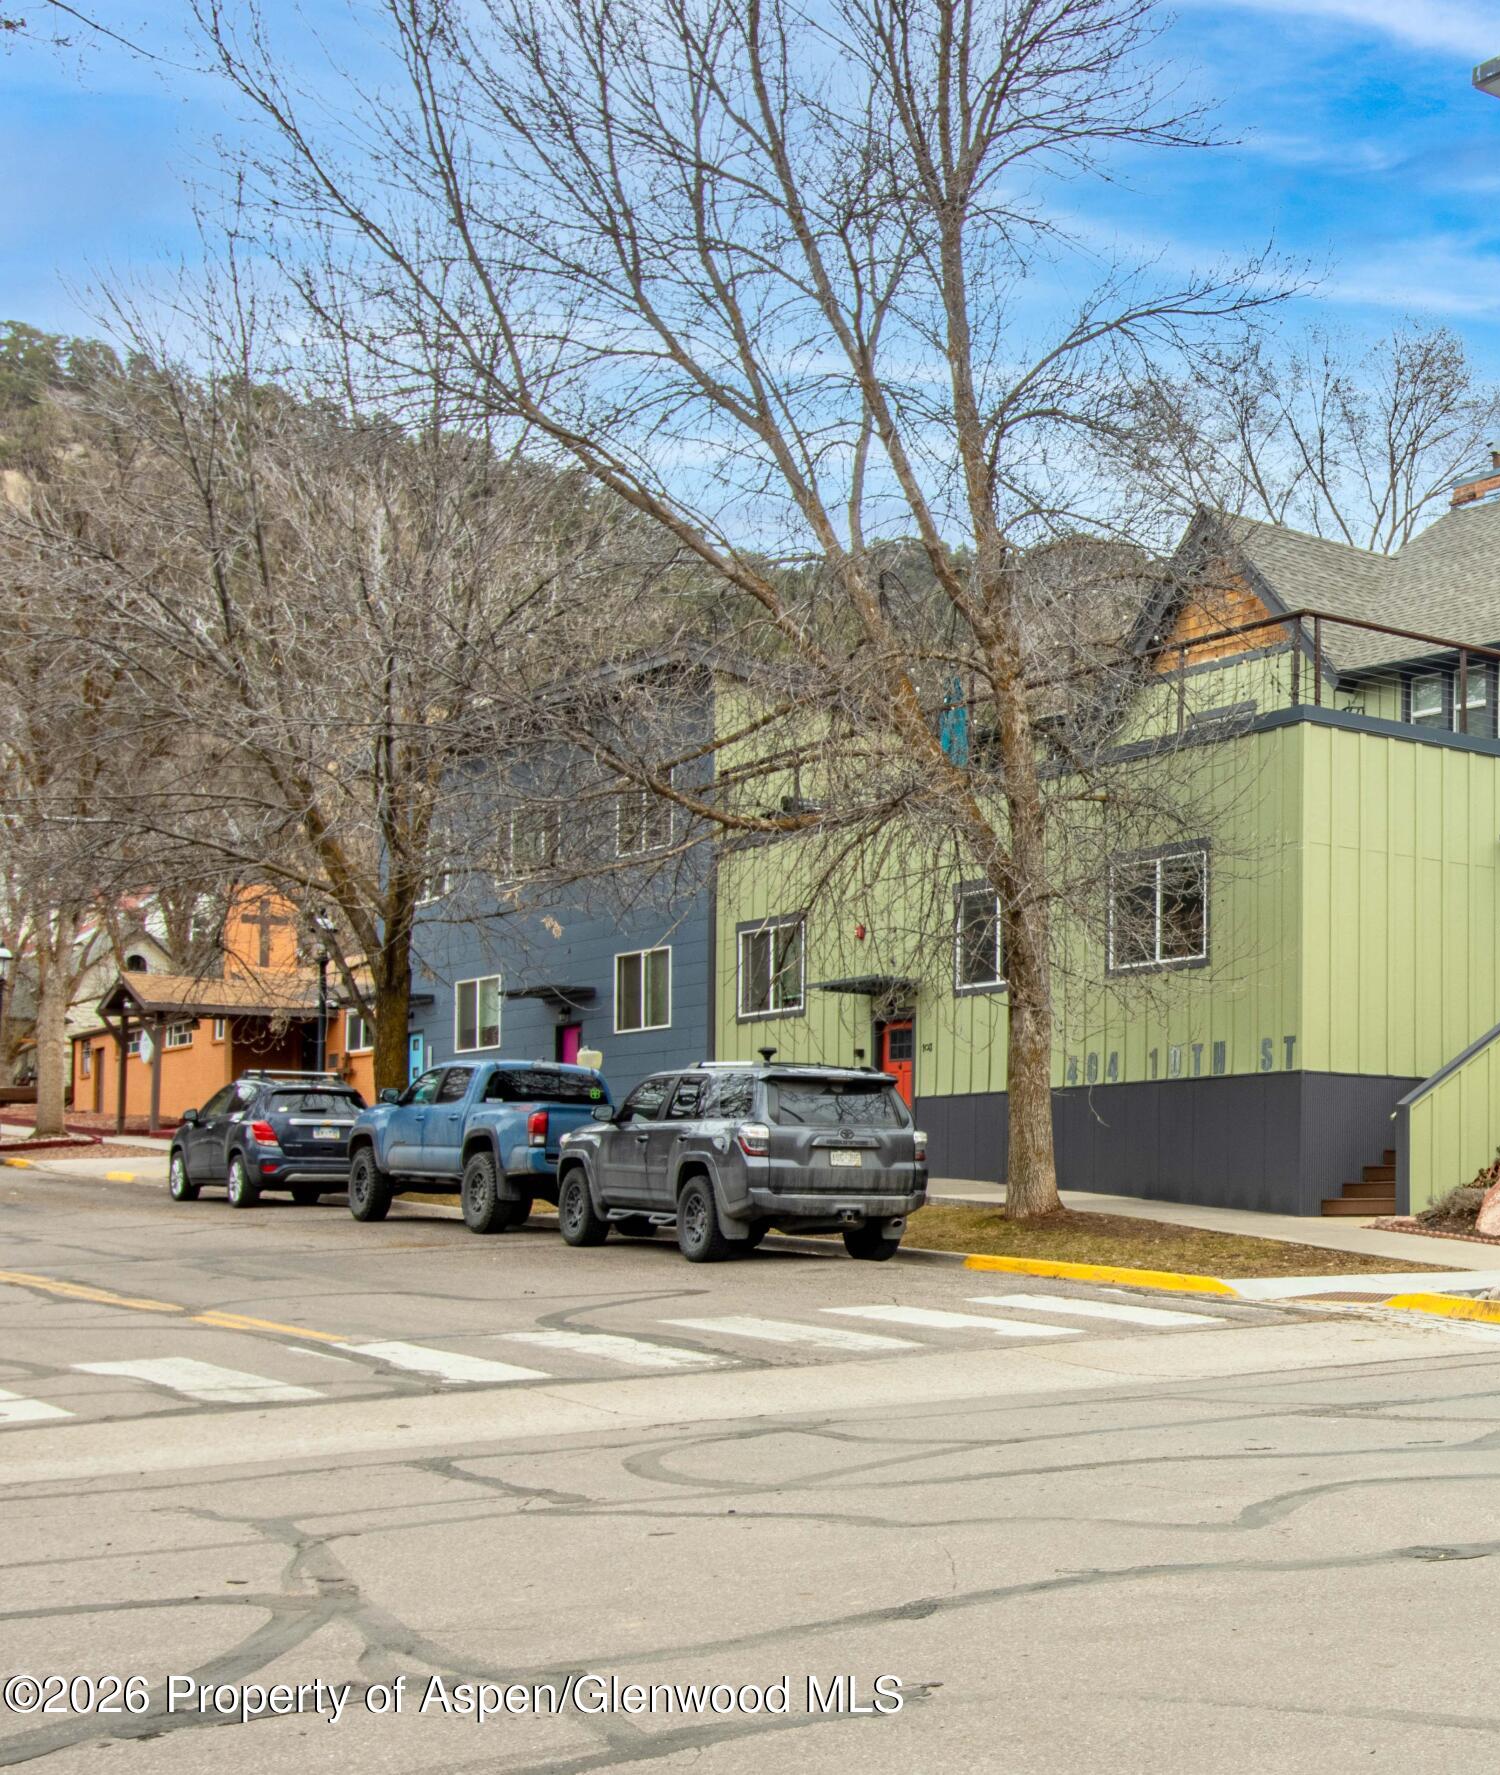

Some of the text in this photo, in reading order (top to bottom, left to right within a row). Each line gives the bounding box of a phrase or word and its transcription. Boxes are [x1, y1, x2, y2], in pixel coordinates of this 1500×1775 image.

[1067, 1036, 1297, 1085] 404 10TH ST
